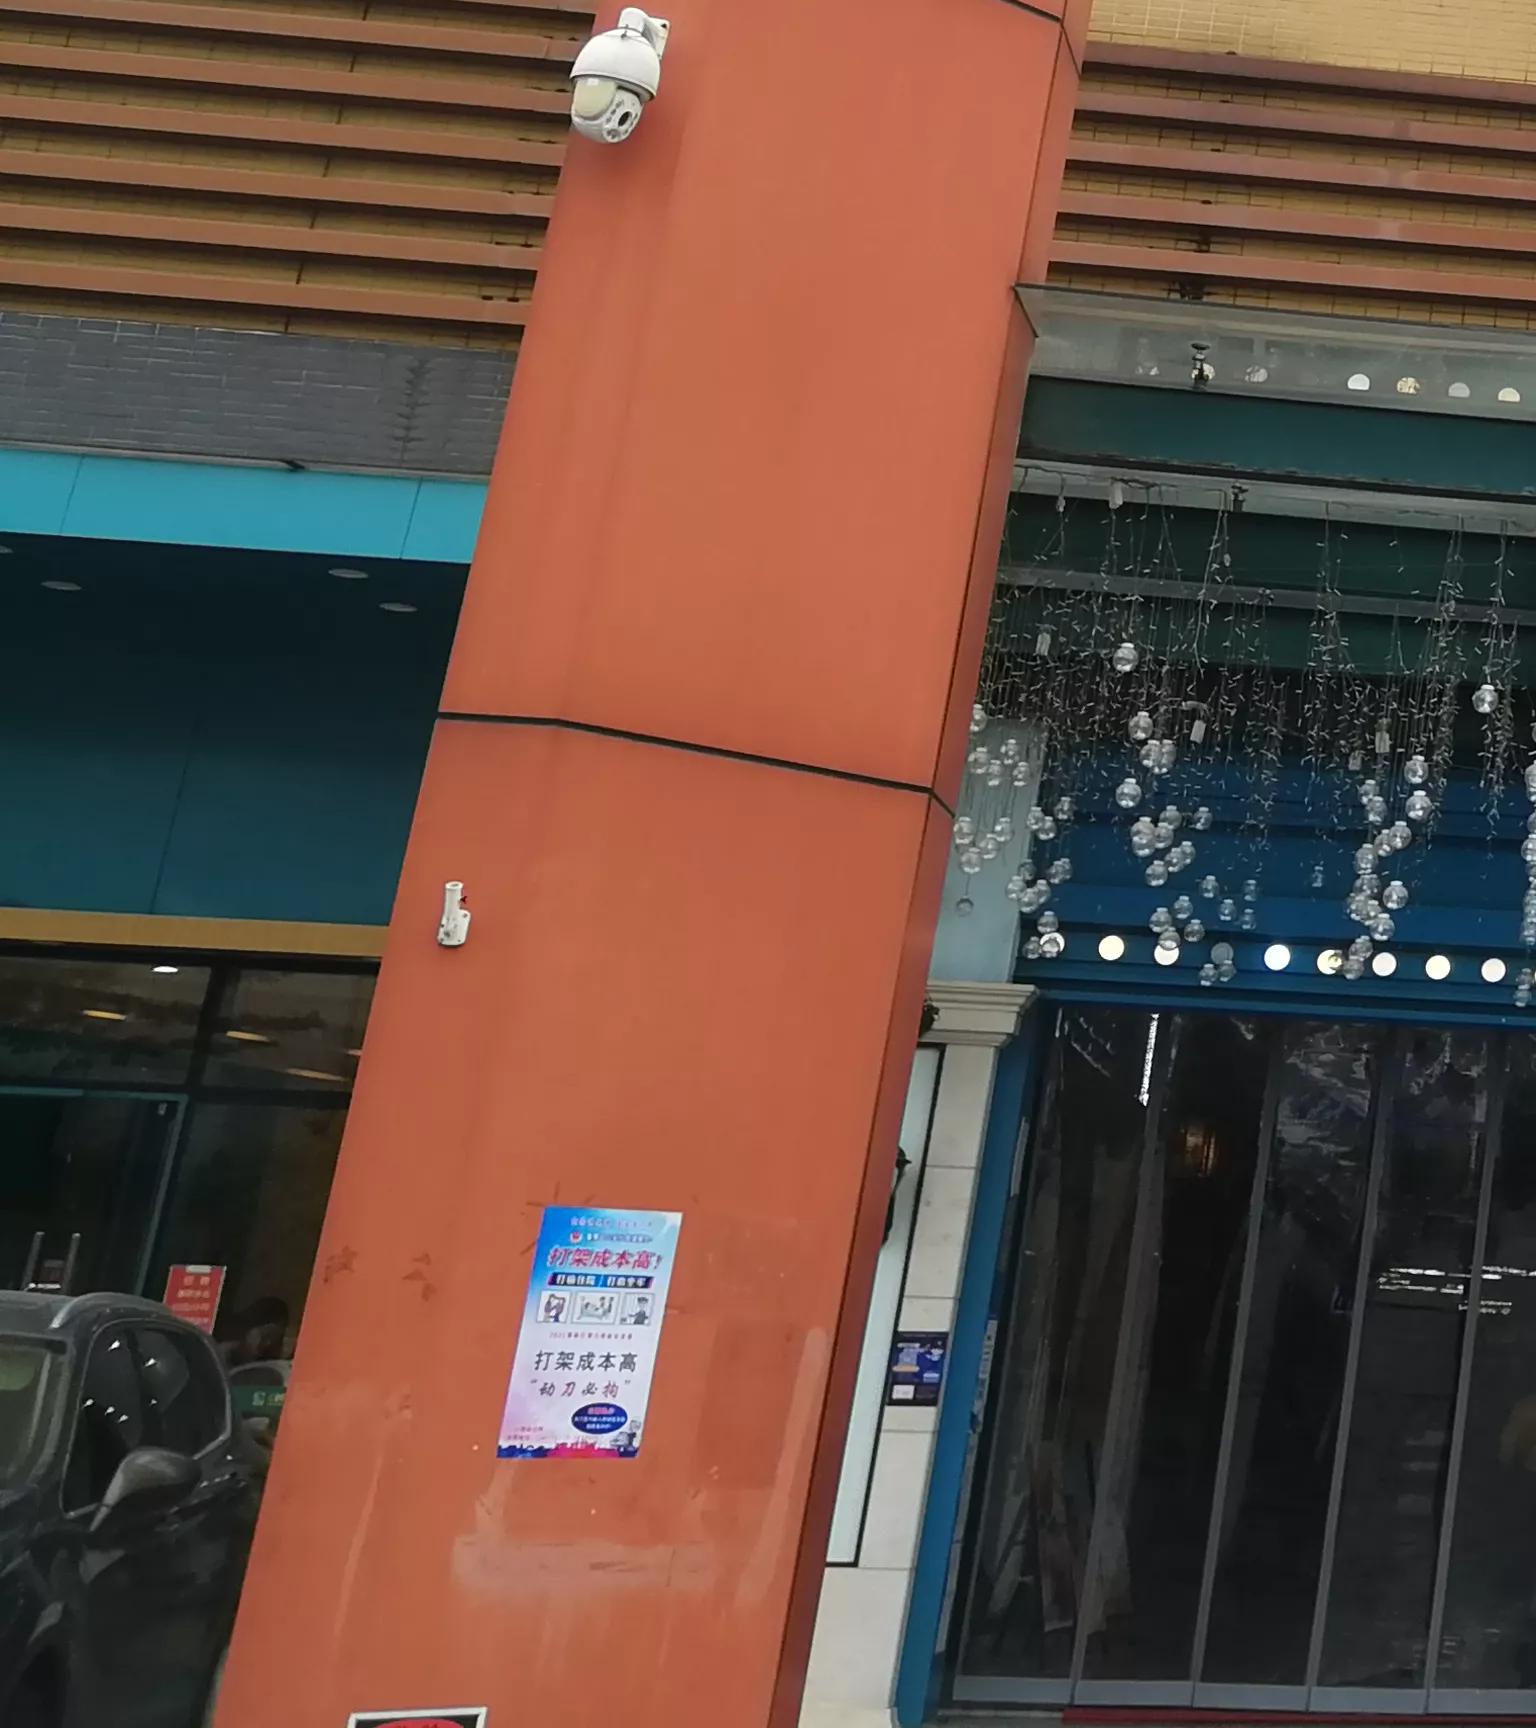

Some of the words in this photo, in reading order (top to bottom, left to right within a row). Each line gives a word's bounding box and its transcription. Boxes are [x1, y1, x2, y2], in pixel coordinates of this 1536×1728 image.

[534, 1350, 639, 1373] 打架成本高
